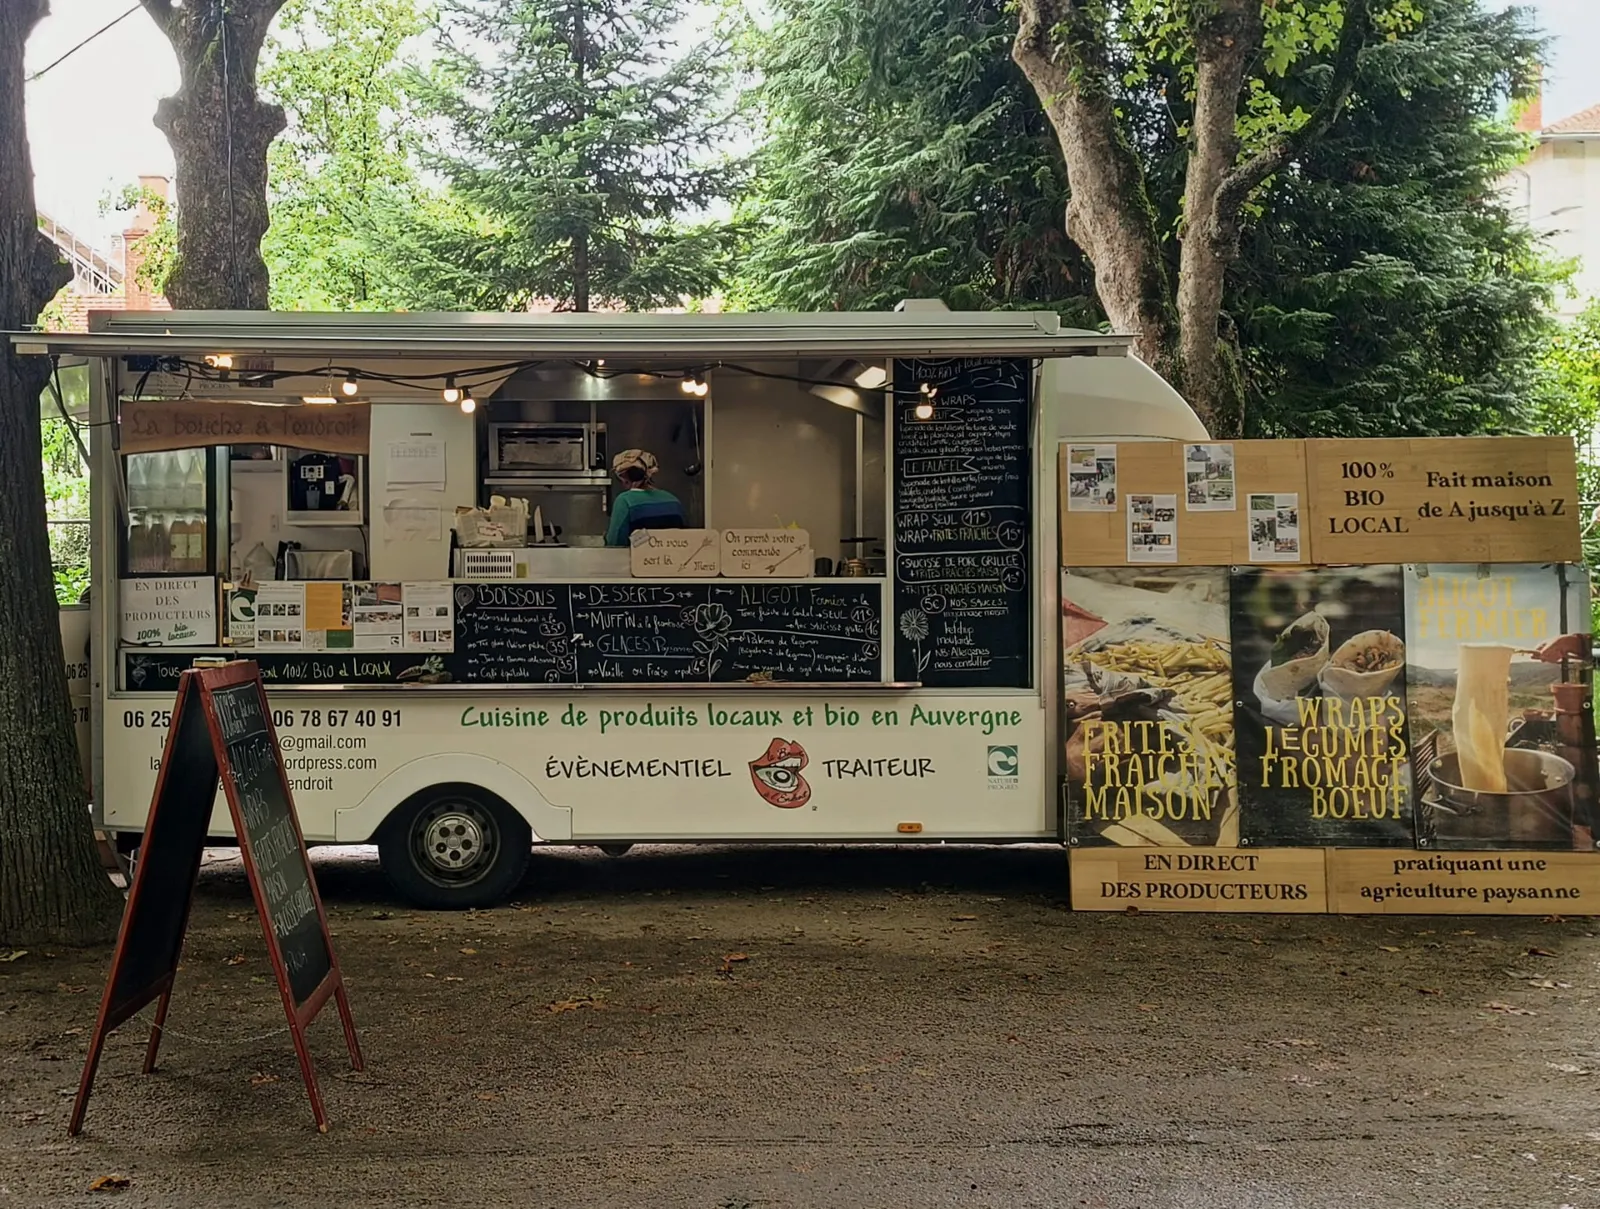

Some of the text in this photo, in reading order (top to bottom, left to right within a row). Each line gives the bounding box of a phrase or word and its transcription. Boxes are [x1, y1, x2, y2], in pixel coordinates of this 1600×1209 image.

[941, 394, 976, 407] WRAPS
[131, 409, 361, 436] La bouche à l'endroit
[907, 459, 963, 473] LE FALAFEL
[1341, 462, 1395, 479] 100%
[1426, 471, 1553, 488] Fait maison
[1344, 489, 1385, 507] BIO
[1417, 499, 1566, 522] de A jusqu'à Z
[897, 513, 929, 528] WRAP
[931, 513, 958, 527] SEUL
[1328, 516, 1410, 534] LOCAL
[648, 536, 663, 548] On
[667, 539, 689, 548] vous
[725, 531, 796, 546] On prend votre
[897, 529, 929, 543] WRAP
[643, 555, 661, 566] sert
[732, 546, 781, 557] commande
[693, 561, 716, 572] Merci
[135, 580, 199, 591] EN DIRECT
[1417, 576, 1518, 608] ALIGOT
[155, 595, 180, 606] DES
[588, 585, 675, 605] DESSERTS
[950, 598, 968, 608] NOS
[125, 610, 212, 621] PRODUCTEURS
[1418, 608, 1548, 639] FERMIER
[137, 628, 161, 640] 100%
[167, 630, 198, 641] locaux
[174, 622, 188, 632] bio
[597, 634, 650, 654] GLACES
[123, 711, 171, 728] 06 25
[273, 710, 402, 728] 06 78 67 40 91
[461, 703, 1022, 735] Cuisine de produits locaux et bio en Auvergne
[1295, 696, 1405, 728] WRAPS
[1081, 720, 1197, 755] FRITES
[1264, 722, 1407, 758] LÉGUMES
[545, 755, 731, 779] ÉVÈNEMENTIEL
[822, 758, 936, 779] TRAITEUR
[1259, 756, 1408, 789] FROMAGE
[1083, 784, 1213, 821] MAISON
[1312, 786, 1409, 820] BOEUF
[1144, 854, 1260, 871] EN DIRECT
[1393, 855, 1547, 875] pratiquant une
[1100, 881, 1308, 900] DES PRODUCTEURS
[1360, 882, 1581, 903] agriculture paysanne
